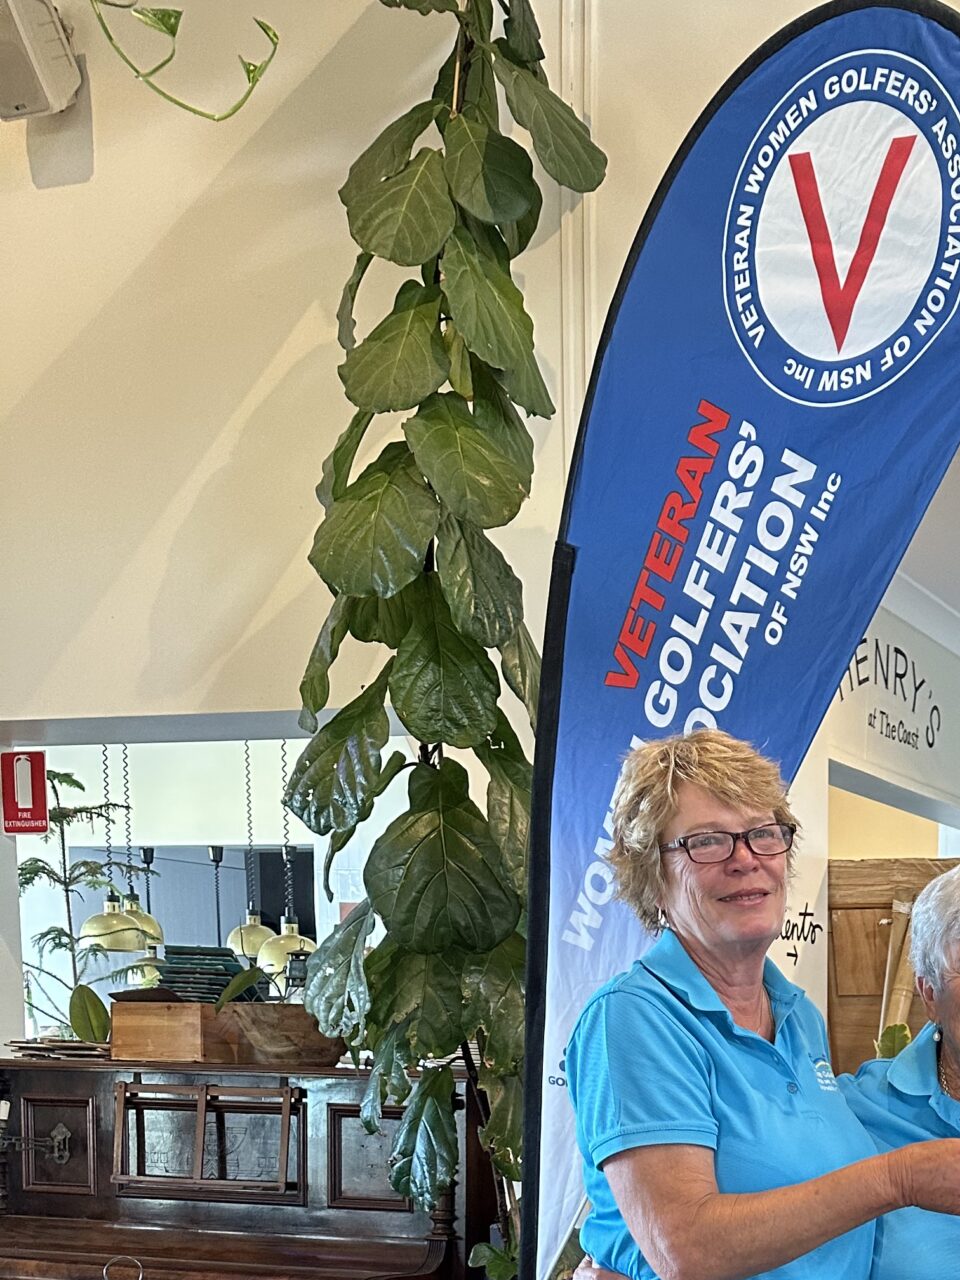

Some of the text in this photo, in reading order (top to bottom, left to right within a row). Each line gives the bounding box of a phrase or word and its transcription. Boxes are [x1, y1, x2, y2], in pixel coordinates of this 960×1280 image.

[744, 89, 818, 196] WOMEN
[788, 134, 918, 355] V
[733, 204, 766, 349] VETERAN
[783, 357, 813, 389] Inc
[880, 334, 911, 371] OF
[817, 359, 872, 392] NSW
[604, 399, 732, 689] VETERAN
[764, 471, 842, 646] OF NSW Inc
[684, 447, 818, 738] OCIATION
[868, 708, 919, 750] at The Coast
[5, 820, 47, 828] EXTINGUISHER
[18, 811, 32, 819] FIRE
[778, 902, 823, 944] ents
[548, 1075, 568, 1087] GO
